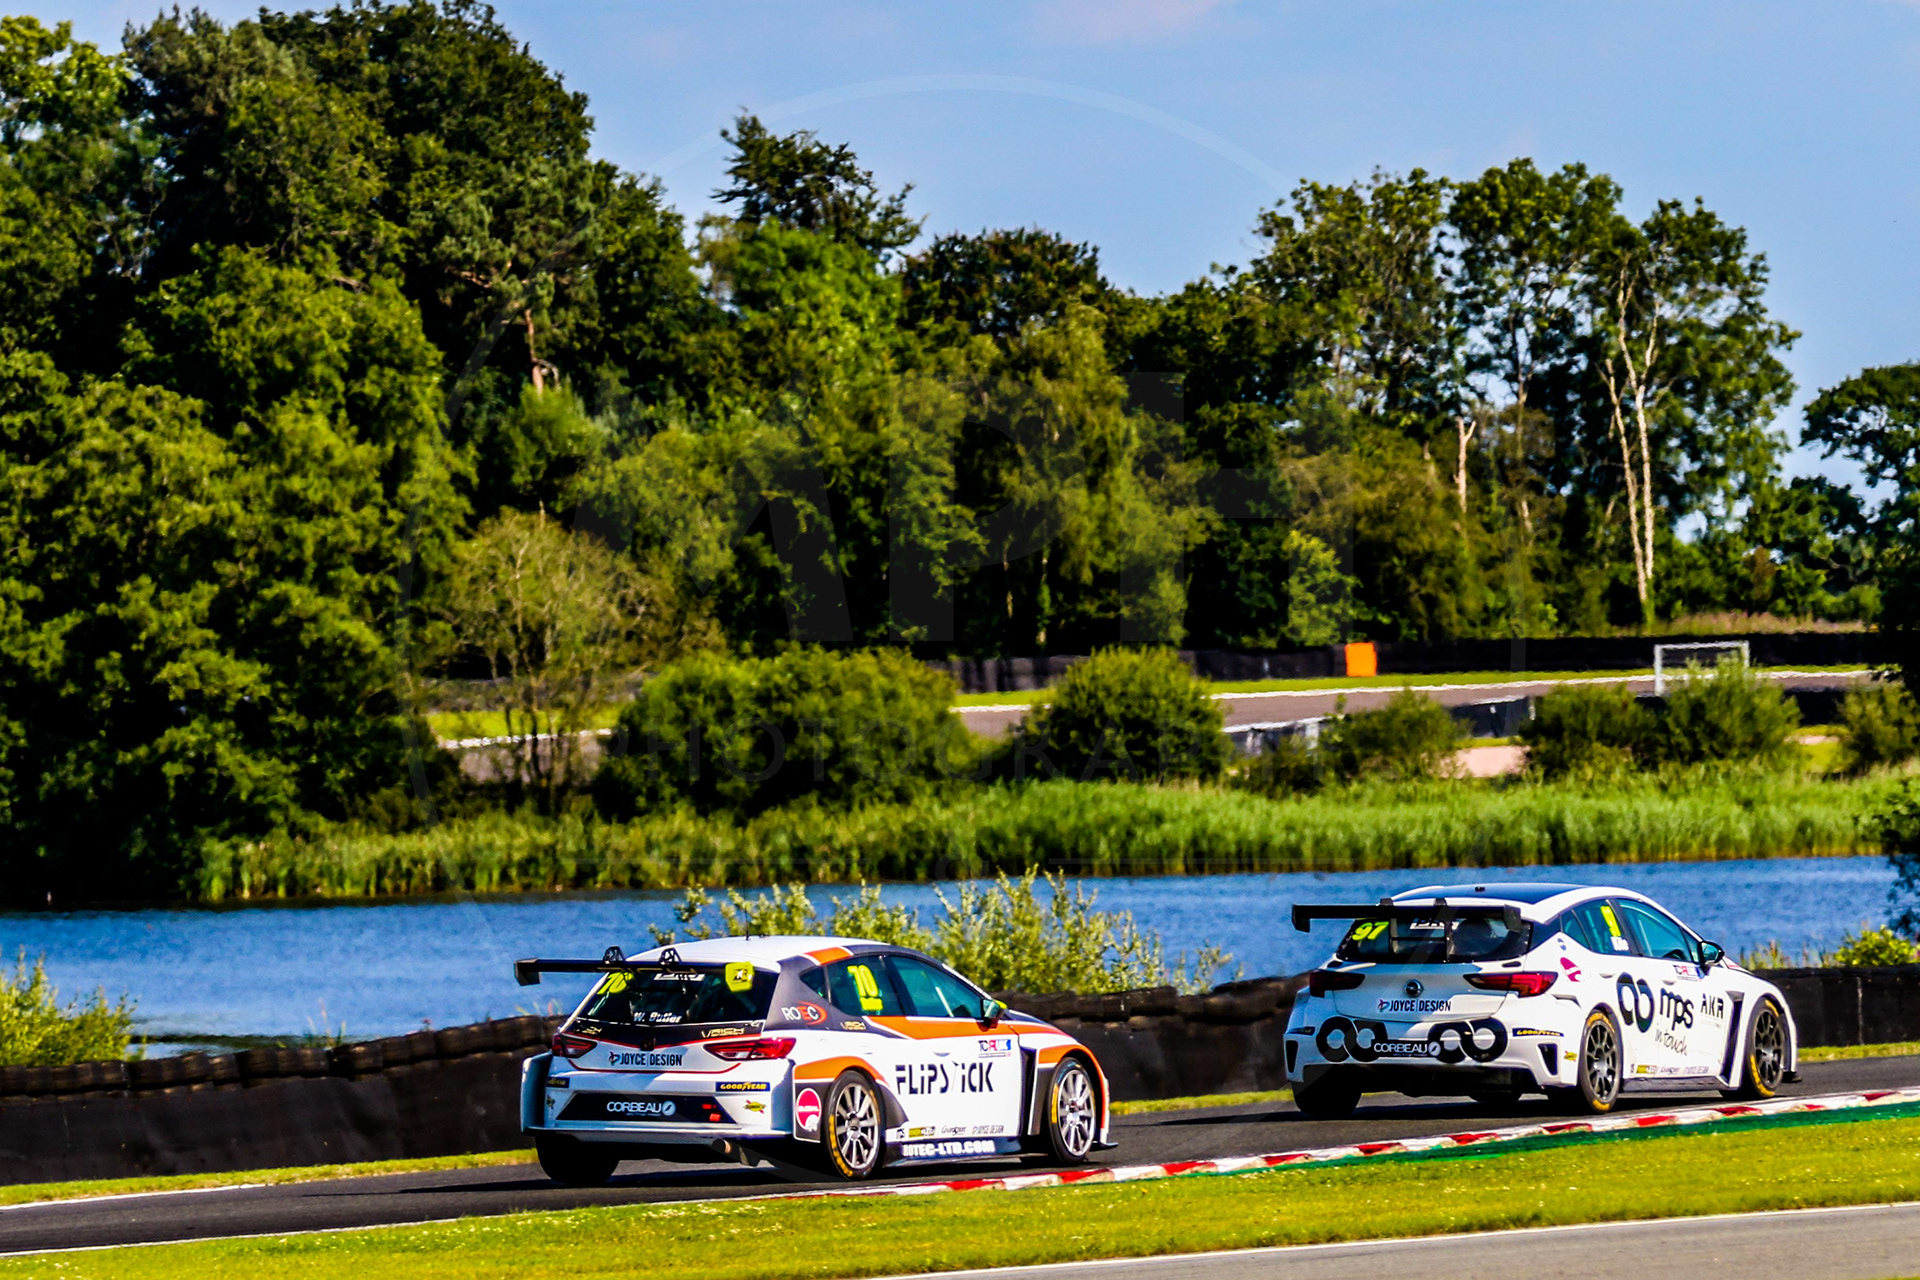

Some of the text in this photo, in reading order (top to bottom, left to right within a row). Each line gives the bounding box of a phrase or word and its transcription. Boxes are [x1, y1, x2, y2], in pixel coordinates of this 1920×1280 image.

[1351, 921, 1389, 940] 97
[847, 964, 879, 997] 10
[1389, 999, 1452, 1012] JOYCE DESIGN
[1659, 987, 1695, 1031] mps
[1700, 993, 1724, 1020] AKR
[1373, 1042, 1428, 1054] CORBEAU
[619, 1052, 683, 1067] JOYCE DESIGN
[720, 1082, 767, 1091] GOODYEAR
[606, 1101, 662, 1113] CORBEAU
